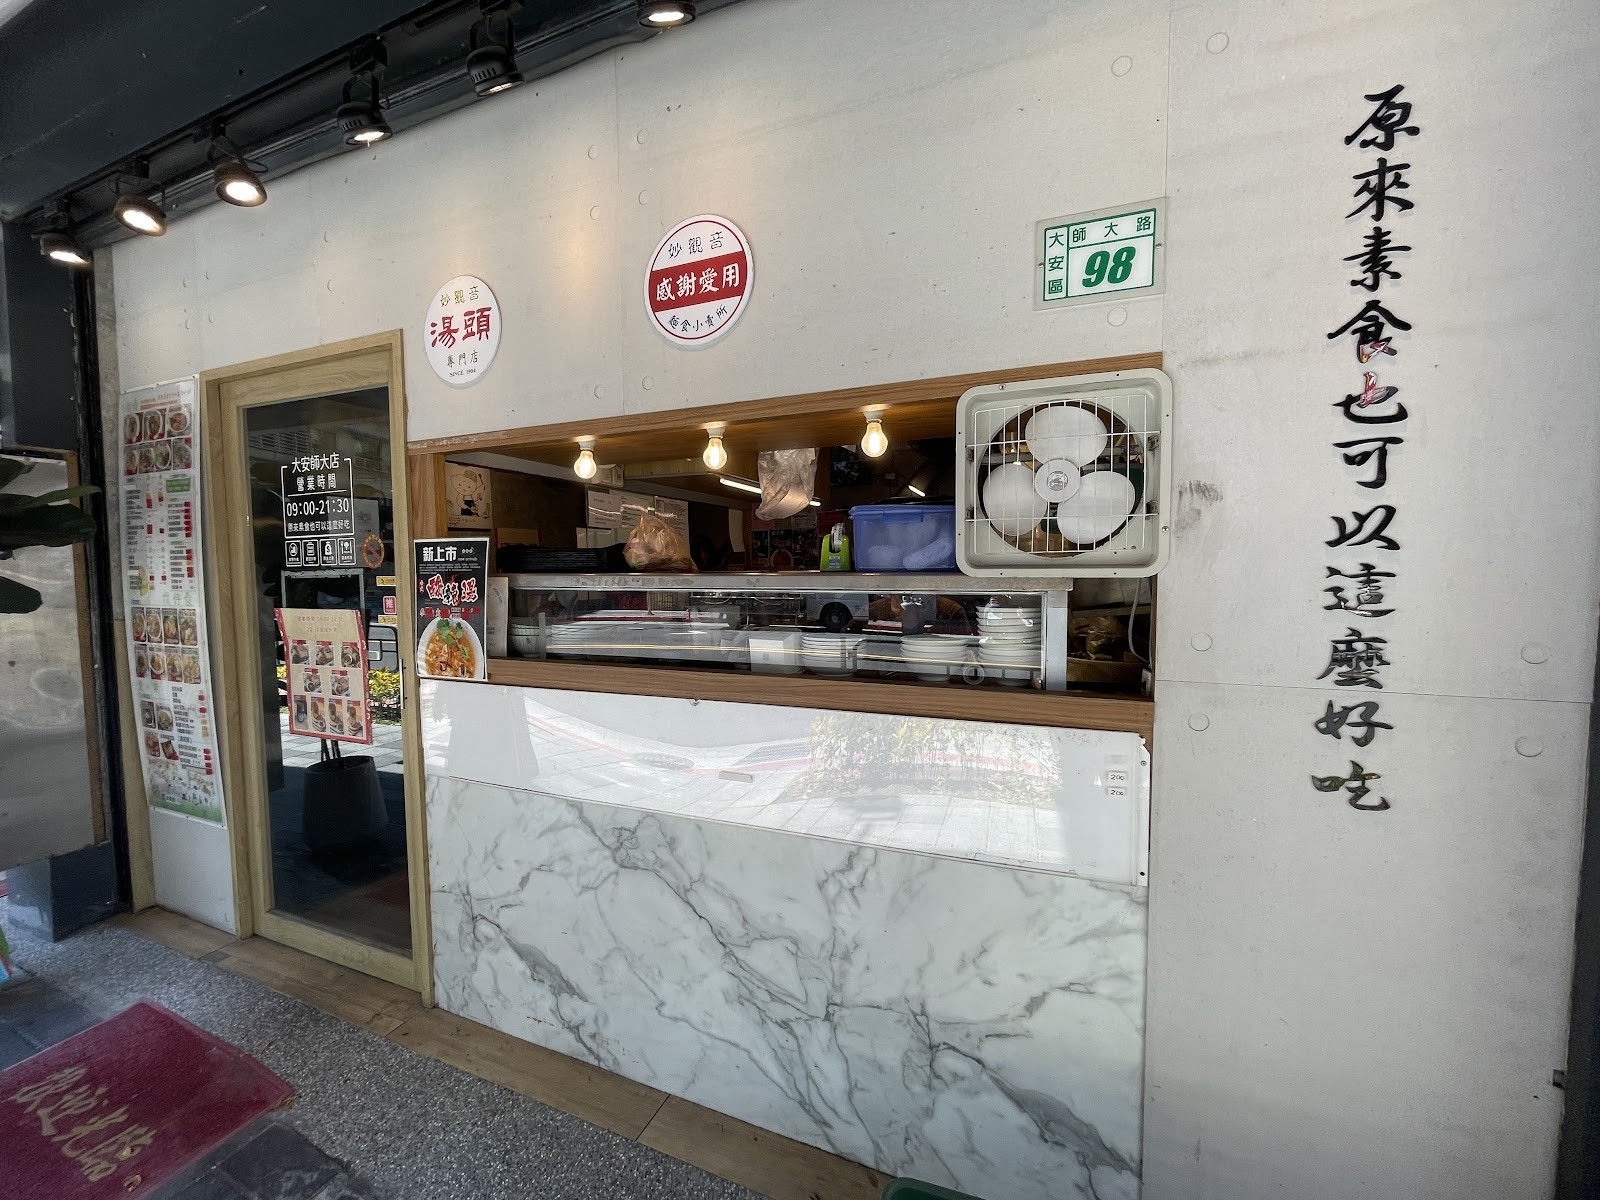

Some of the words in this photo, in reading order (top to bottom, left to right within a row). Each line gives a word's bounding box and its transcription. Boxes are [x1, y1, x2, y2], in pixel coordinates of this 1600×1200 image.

[1072, 216, 1151, 242] 師大路
[668, 231, 724, 259] 妙觀音
[1048, 232, 1064, 295] 大安區
[1082, 246, 1136, 288] 98
[656, 263, 740, 301] 感謝愛用
[430, 307, 492, 349] 湯頭
[1311, 84, 1420, 812] 原來素食也可以這麼好吃
[291, 452, 340, 473] 大安師大店
[297, 473, 336, 492] 營業時間
[286, 498, 349, 517] 09:00-21:30
[422, 546, 457, 562] 新上市
